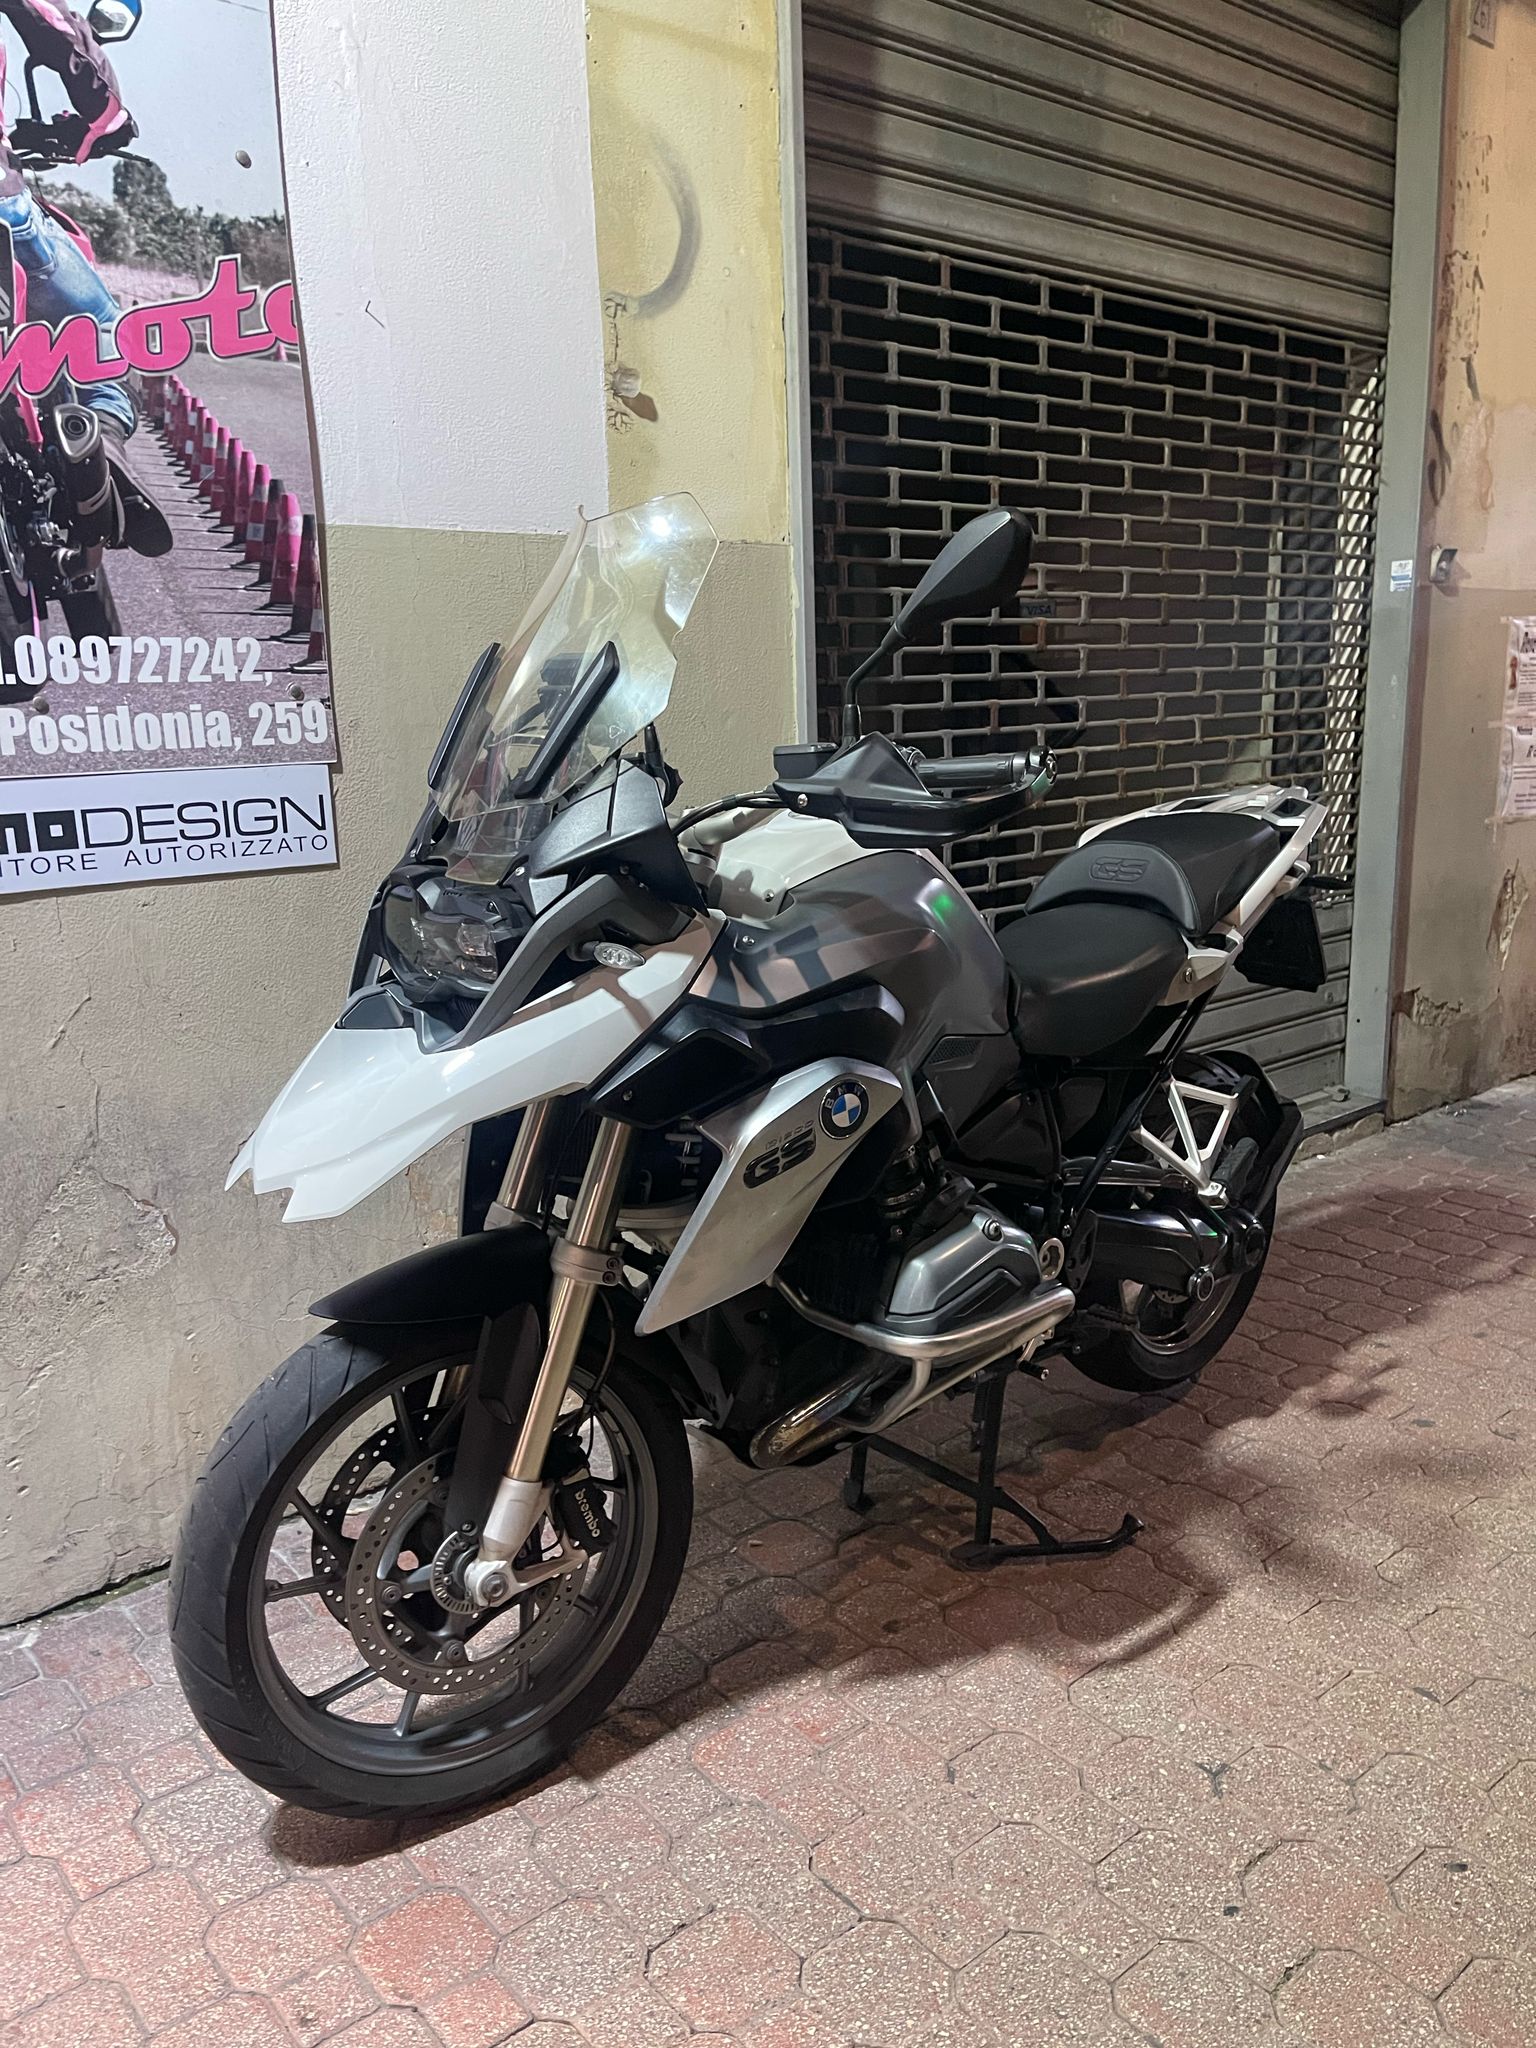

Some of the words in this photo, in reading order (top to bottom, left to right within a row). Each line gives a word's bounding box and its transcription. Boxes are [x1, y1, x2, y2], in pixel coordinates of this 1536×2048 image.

[0, 704, 242, 755] Posidonia,
[249, 701, 328, 746] 259
[123, 834, 329, 867] AUTORIZZATO
[824, 1084, 864, 1109] BMW
[743, 1128, 816, 1188] GS
[575, 1488, 600, 1537] brembo
